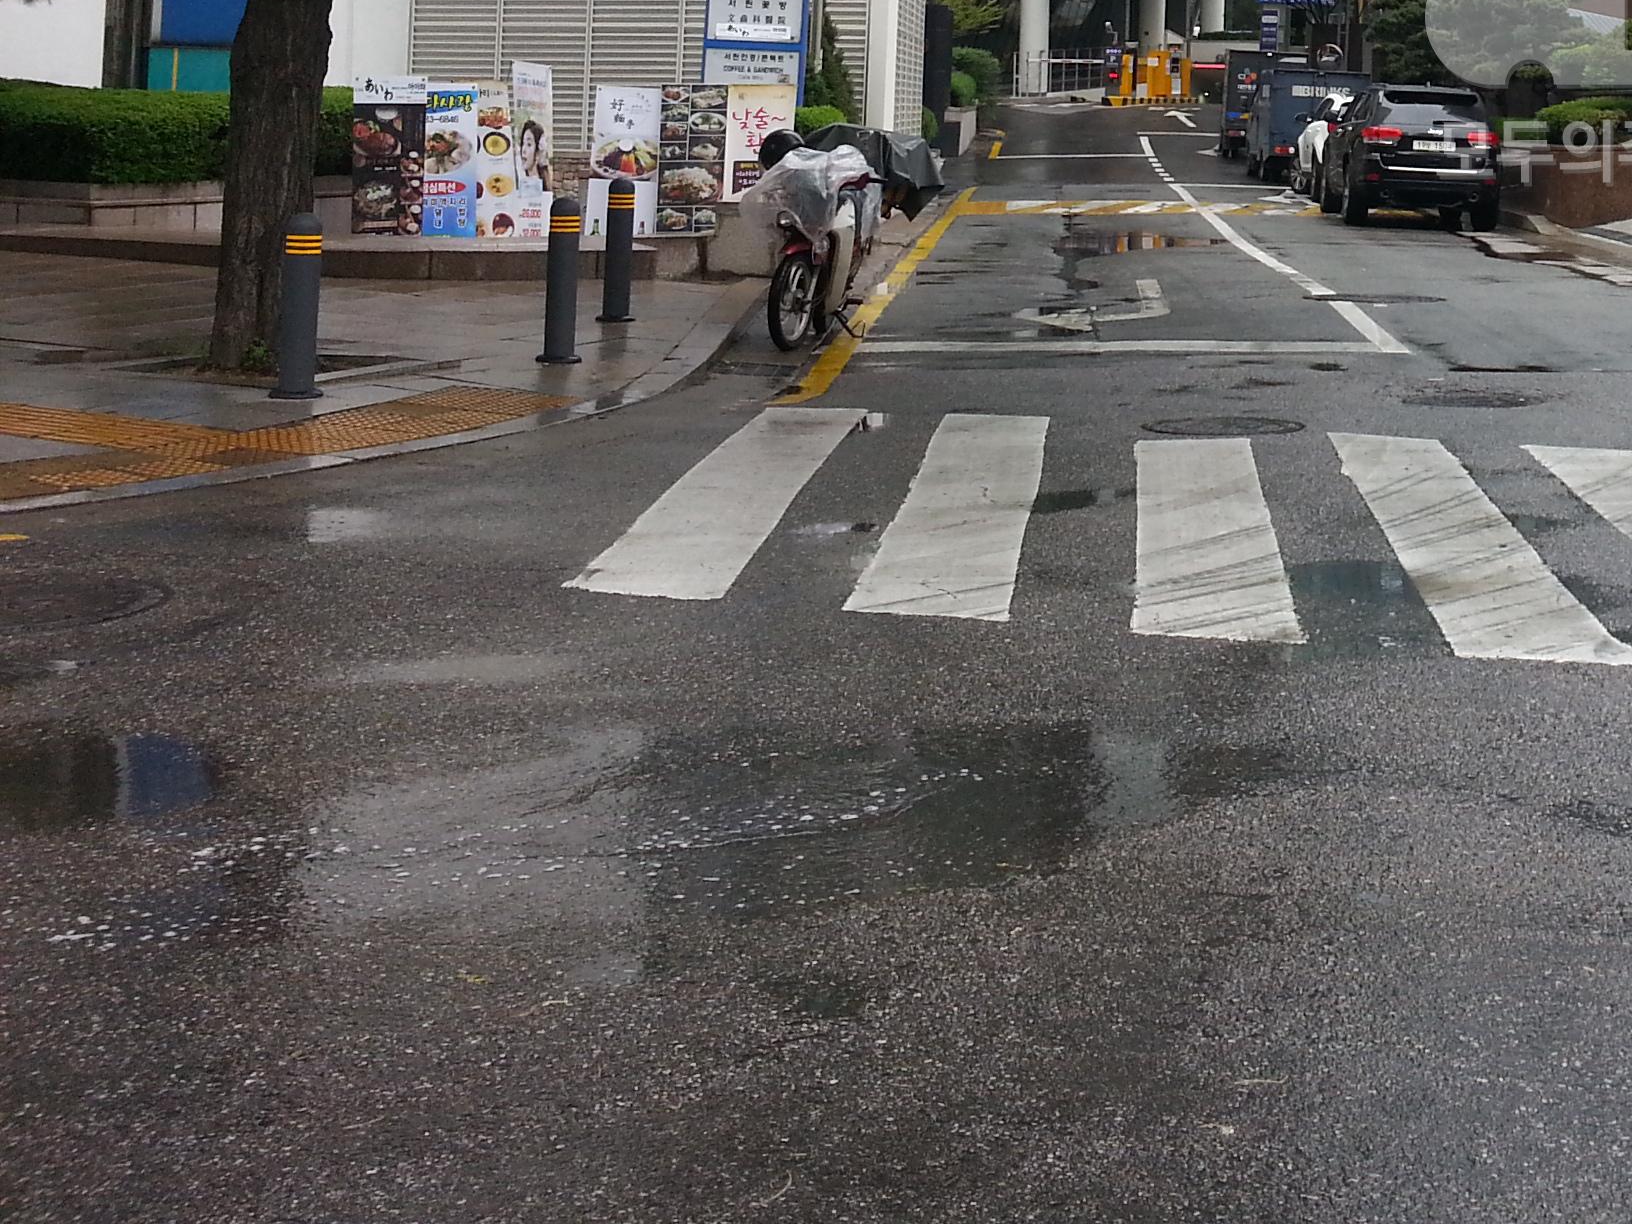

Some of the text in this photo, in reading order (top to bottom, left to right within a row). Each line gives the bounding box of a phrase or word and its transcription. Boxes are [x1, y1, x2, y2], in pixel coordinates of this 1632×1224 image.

[723, 64, 745, 73] COFFEE
[753, 66, 784, 74] SANDWICH
[364, 77, 394, 101] あいわ
